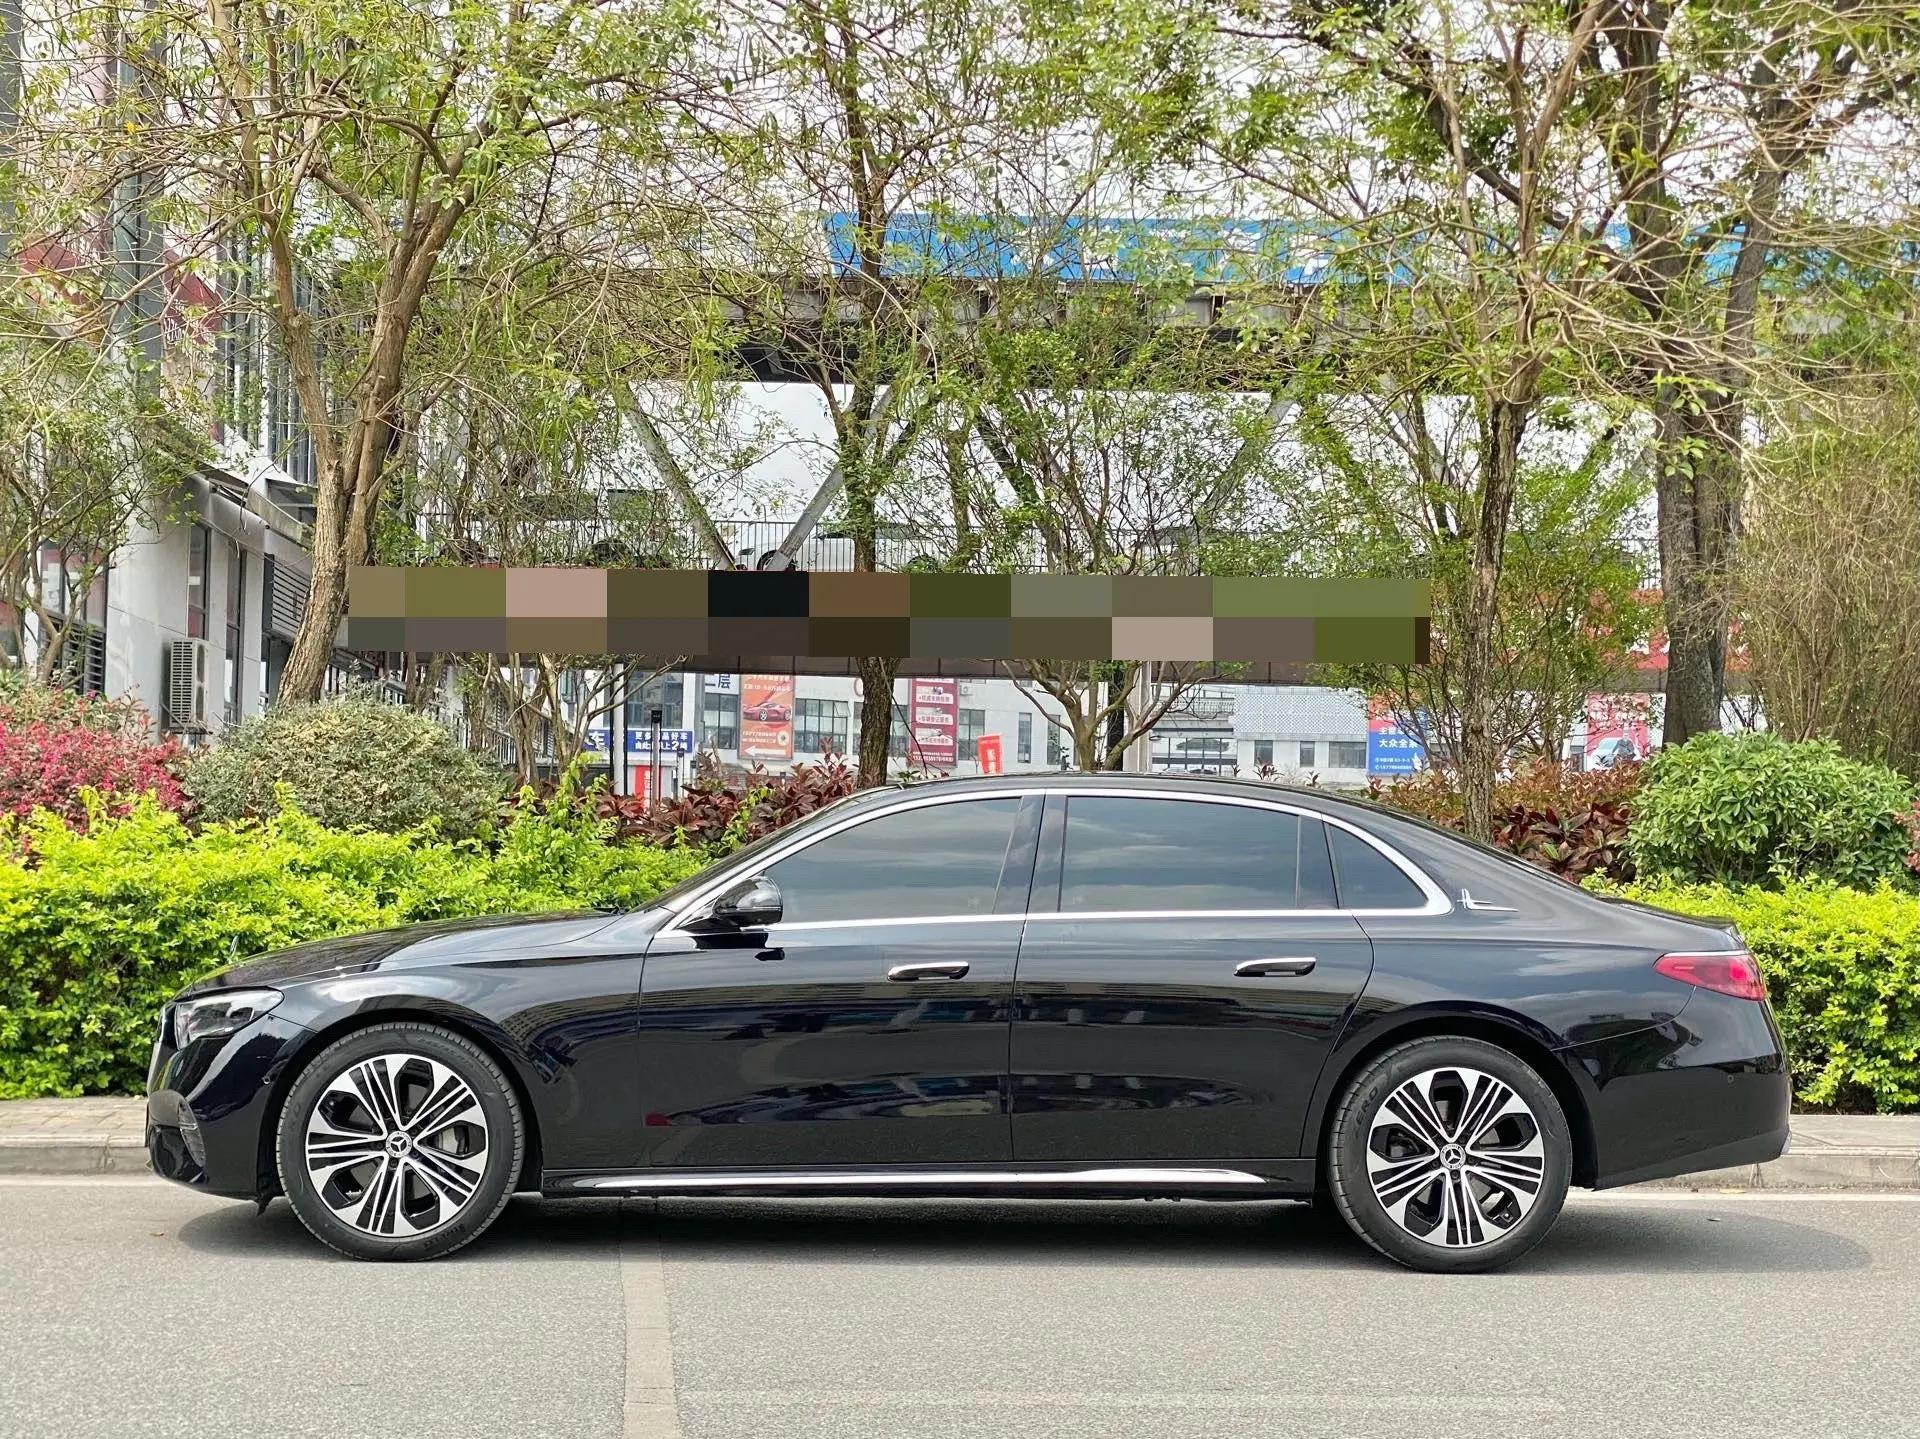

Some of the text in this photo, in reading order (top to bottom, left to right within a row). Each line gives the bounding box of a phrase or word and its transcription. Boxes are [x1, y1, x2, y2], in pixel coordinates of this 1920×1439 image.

[635, 731, 688, 741] 更多品好车
